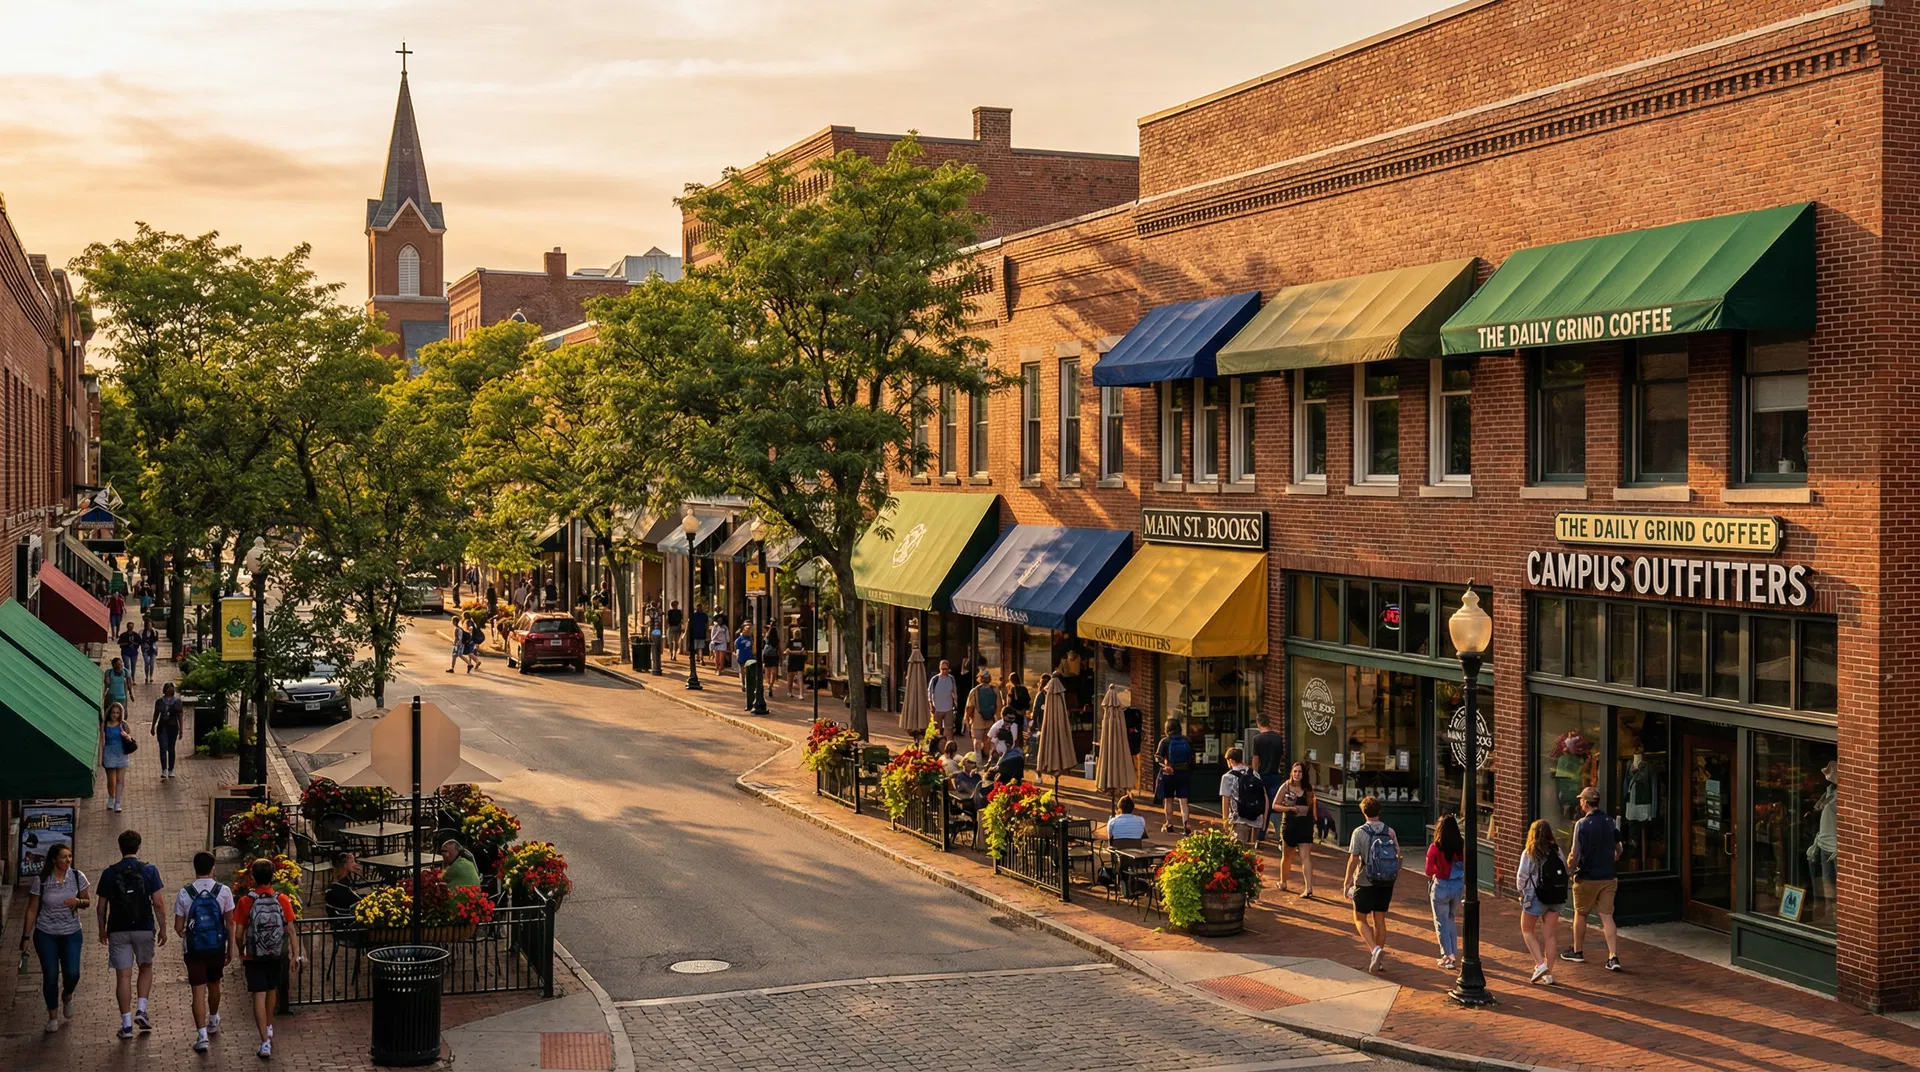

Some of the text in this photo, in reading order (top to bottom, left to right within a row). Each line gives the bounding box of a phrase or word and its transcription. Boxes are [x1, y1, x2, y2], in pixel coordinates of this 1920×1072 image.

[1477, 307, 1672, 349] THE DAILY GRIND COFFEE
[1144, 514, 1260, 541] MAIN ST. BOOKS
[1560, 517, 1771, 545] THE DAILY GRIND COFFEE
[1527, 550, 1807, 606] CAMPUS OUTFITTERS
[1125, 632, 1171, 652] OUTFITTERS
